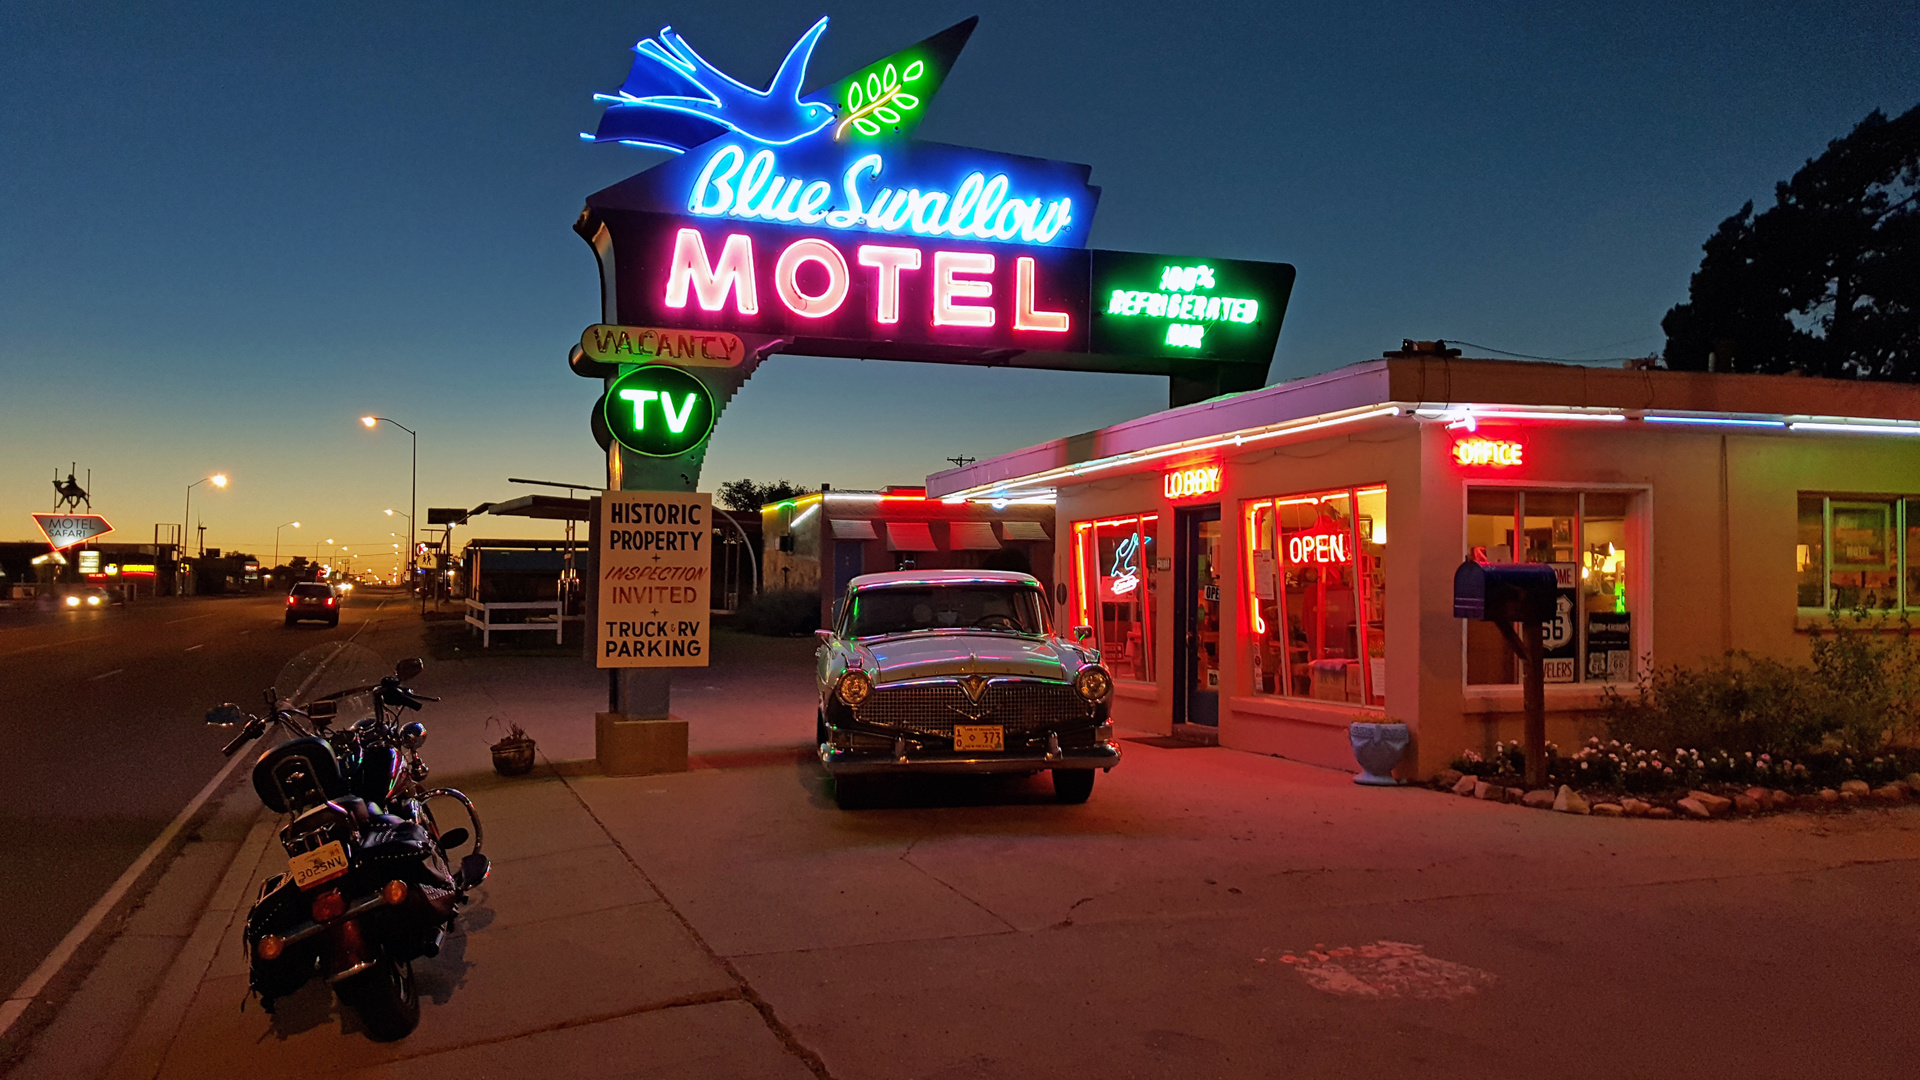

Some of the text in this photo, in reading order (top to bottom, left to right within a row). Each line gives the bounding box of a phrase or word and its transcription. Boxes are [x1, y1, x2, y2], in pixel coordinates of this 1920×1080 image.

[688, 144, 1072, 243] Blue Swallow
[664, 227, 1071, 332] MOTEL
[1159, 265, 1216, 292] 100%
[1107, 289, 1259, 324] REFRIGERATED
[594, 328, 738, 361] VACANCY
[619, 388, 698, 433] TV
[1459, 441, 1523, 465] OFFICE
[1164, 467, 1220, 498] LOBBY
[48, 518, 96, 530] MOTEL
[611, 502, 702, 525] HISTORIC
[48, 529, 86, 538] SAFARI
[609, 529, 703, 551] PROPERTY
[1289, 533, 1346, 563] OPEN
[604, 565, 708, 582] INSPECTION
[612, 586, 698, 604] INVITED
[1206, 586, 1220, 600] OPE
[606, 621, 668, 637] TRUCK
[678, 621, 700, 637] RV
[1542, 616, 1563, 640] 66
[605, 640, 702, 658] PARKING
[982, 732, 1001, 744] 373
